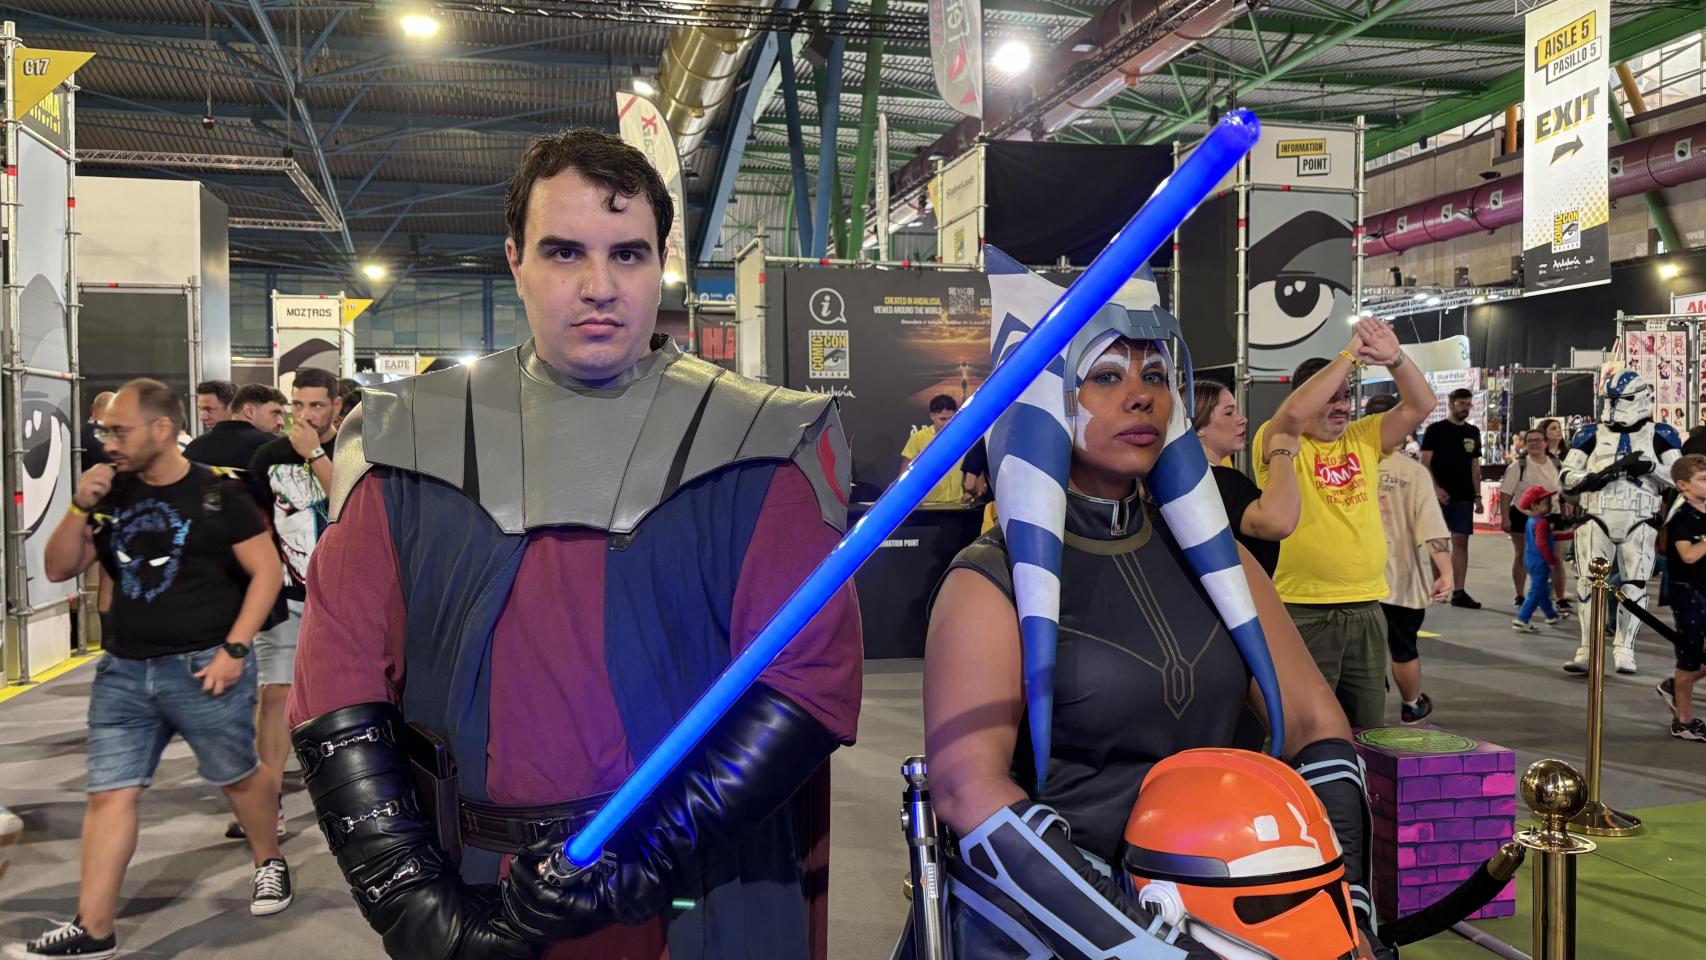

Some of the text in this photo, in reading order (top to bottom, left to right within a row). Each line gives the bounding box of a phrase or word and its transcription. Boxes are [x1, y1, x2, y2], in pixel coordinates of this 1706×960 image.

[1544, 19, 1590, 59] AISLE 5
[1553, 42, 1597, 76] PASILLO 5
[23, 58, 50, 76] C17
[1536, 87, 1600, 141] EXIT
[1281, 141, 1323, 153] INFORMATION
[1302, 158, 1327, 171] POINT
[1562, 211, 1579, 224] CON
[884, 297, 906, 305] CREATED
[907, 297, 913, 305] IN
[1687, 299, 1706, 313] AI
[286, 308, 332, 318] MOZTROS
[873, 305, 893, 314] VIEWED
[893, 306, 914, 314] AROUND
[915, 306, 924, 314] THE
[823, 336, 846, 347] CON
[811, 336, 824, 370] COMIC
[904, 538, 919, 547] POINT
